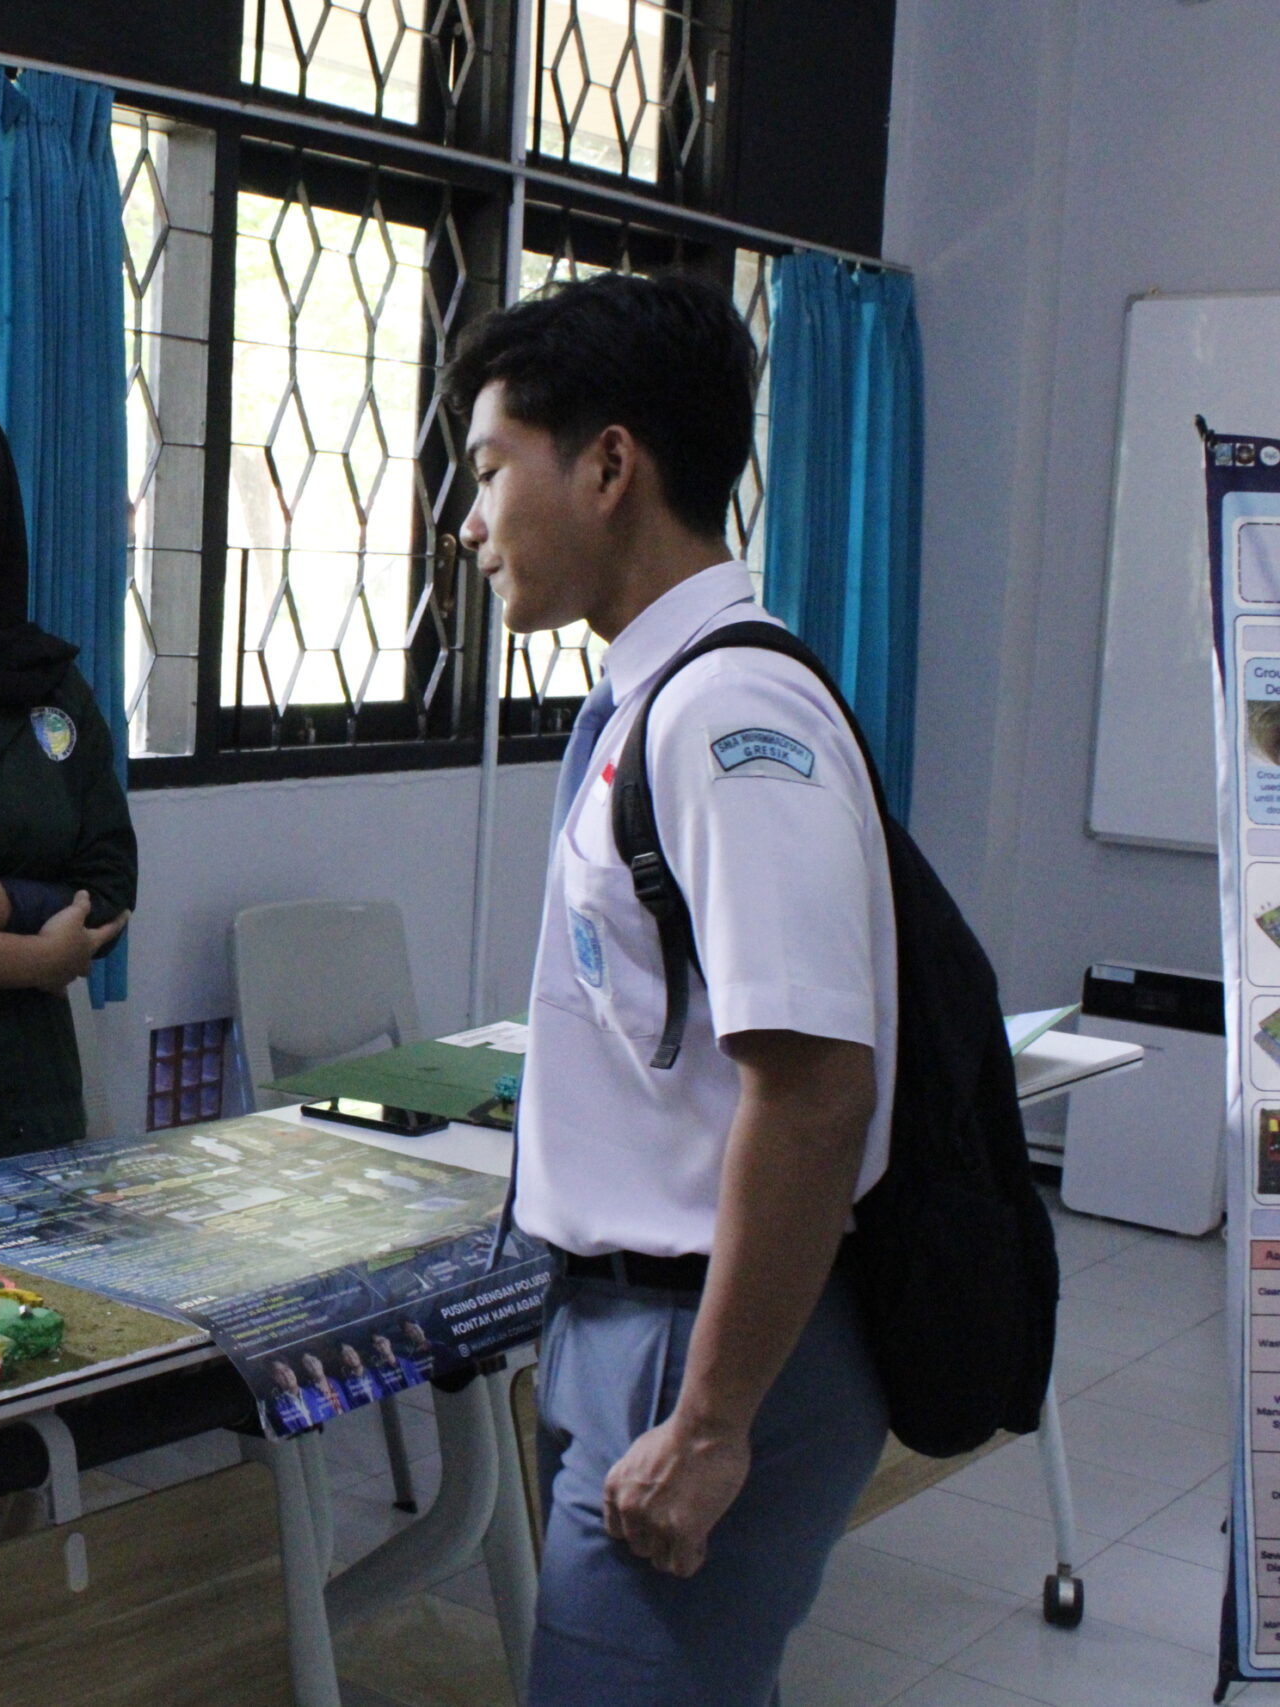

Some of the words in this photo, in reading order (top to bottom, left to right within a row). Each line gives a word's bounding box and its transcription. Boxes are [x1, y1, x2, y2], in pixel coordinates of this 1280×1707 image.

[743, 744, 790, 760] GRESIK
[440, 1298, 478, 1320] PUSING
[476, 1284, 517, 1307] DENGAN
[451, 1313, 492, 1336] KONTAK
[491, 1303, 517, 1321] KAMI
[516, 1294, 541, 1313] AGAR
